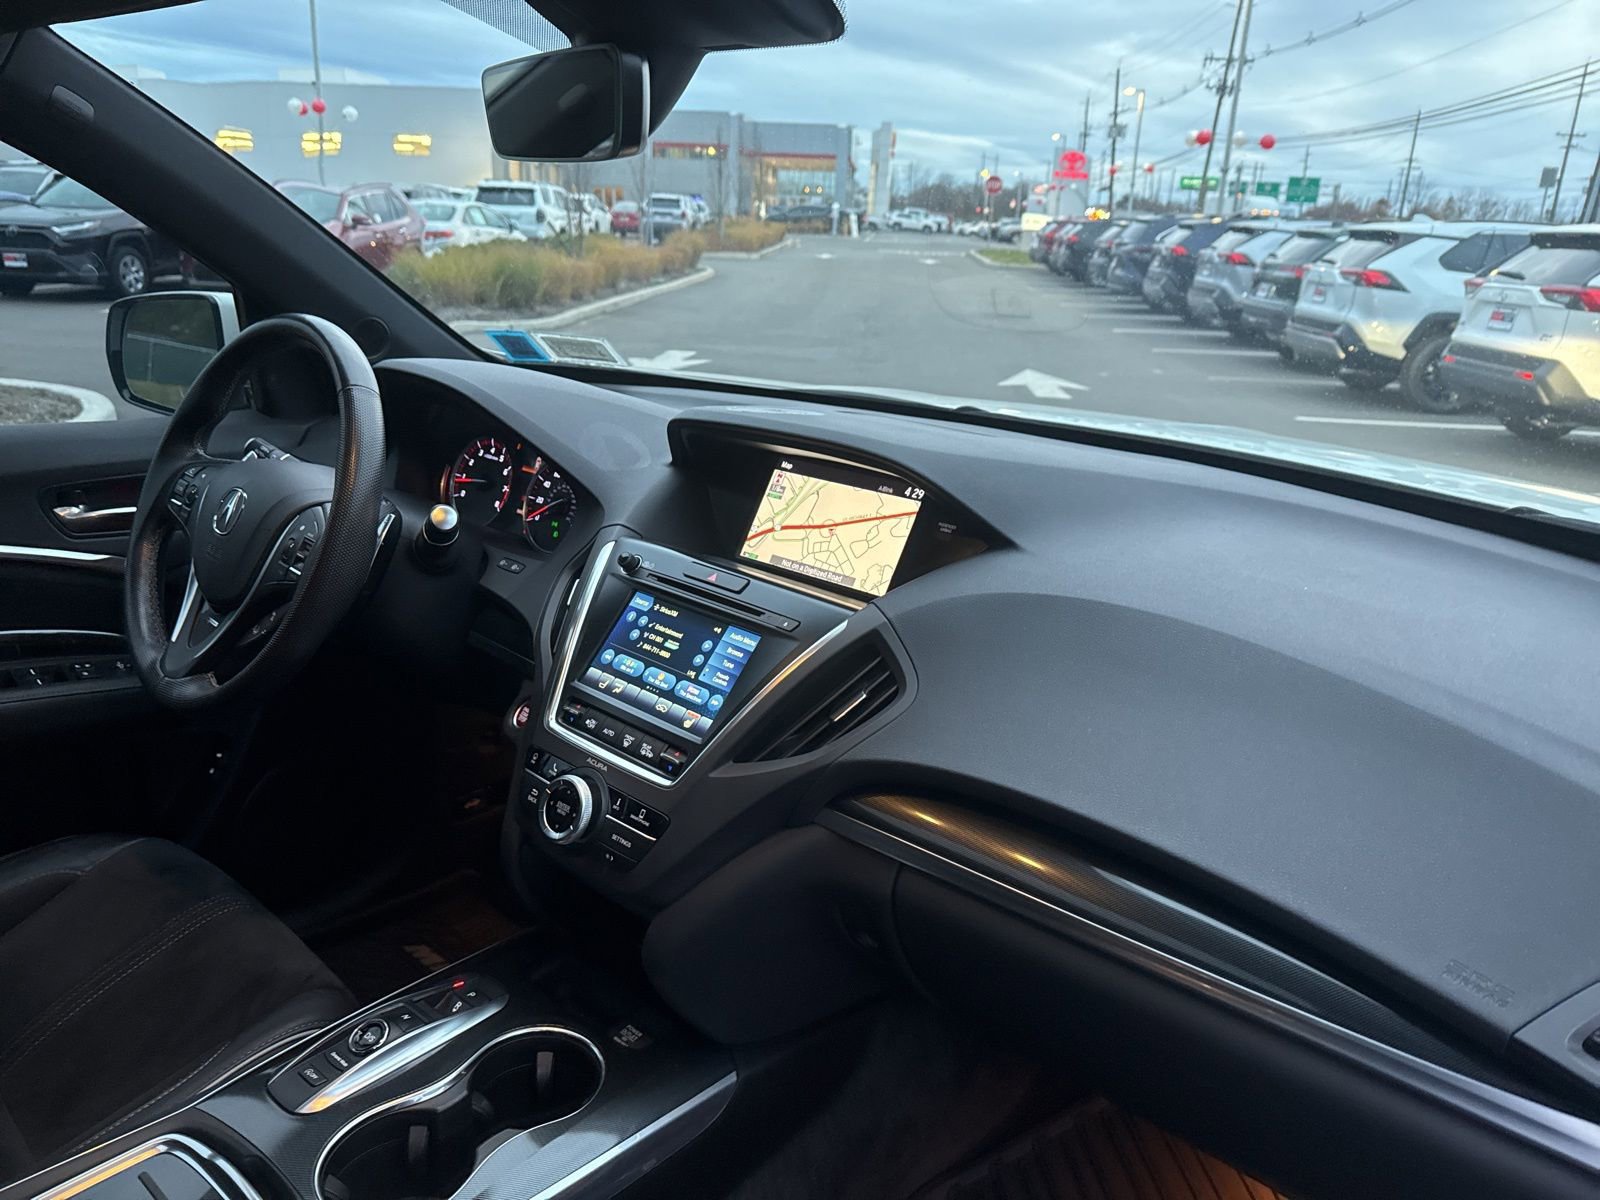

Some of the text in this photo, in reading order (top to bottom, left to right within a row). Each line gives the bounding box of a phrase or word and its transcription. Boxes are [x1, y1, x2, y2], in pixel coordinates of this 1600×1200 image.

[478, 449, 485, 457] 3
[781, 461, 793, 470] Map
[904, 486, 912, 497] 4
[912, 488, 925, 499] 29
[781, 559, 792, 569] Not
[791, 563, 800, 571] on
[827, 572, 843, 582] Road
[602, 727, 616, 738] AUTO
[586, 757, 609, 772] ACURA
[611, 833, 632, 849] SETTINGS
